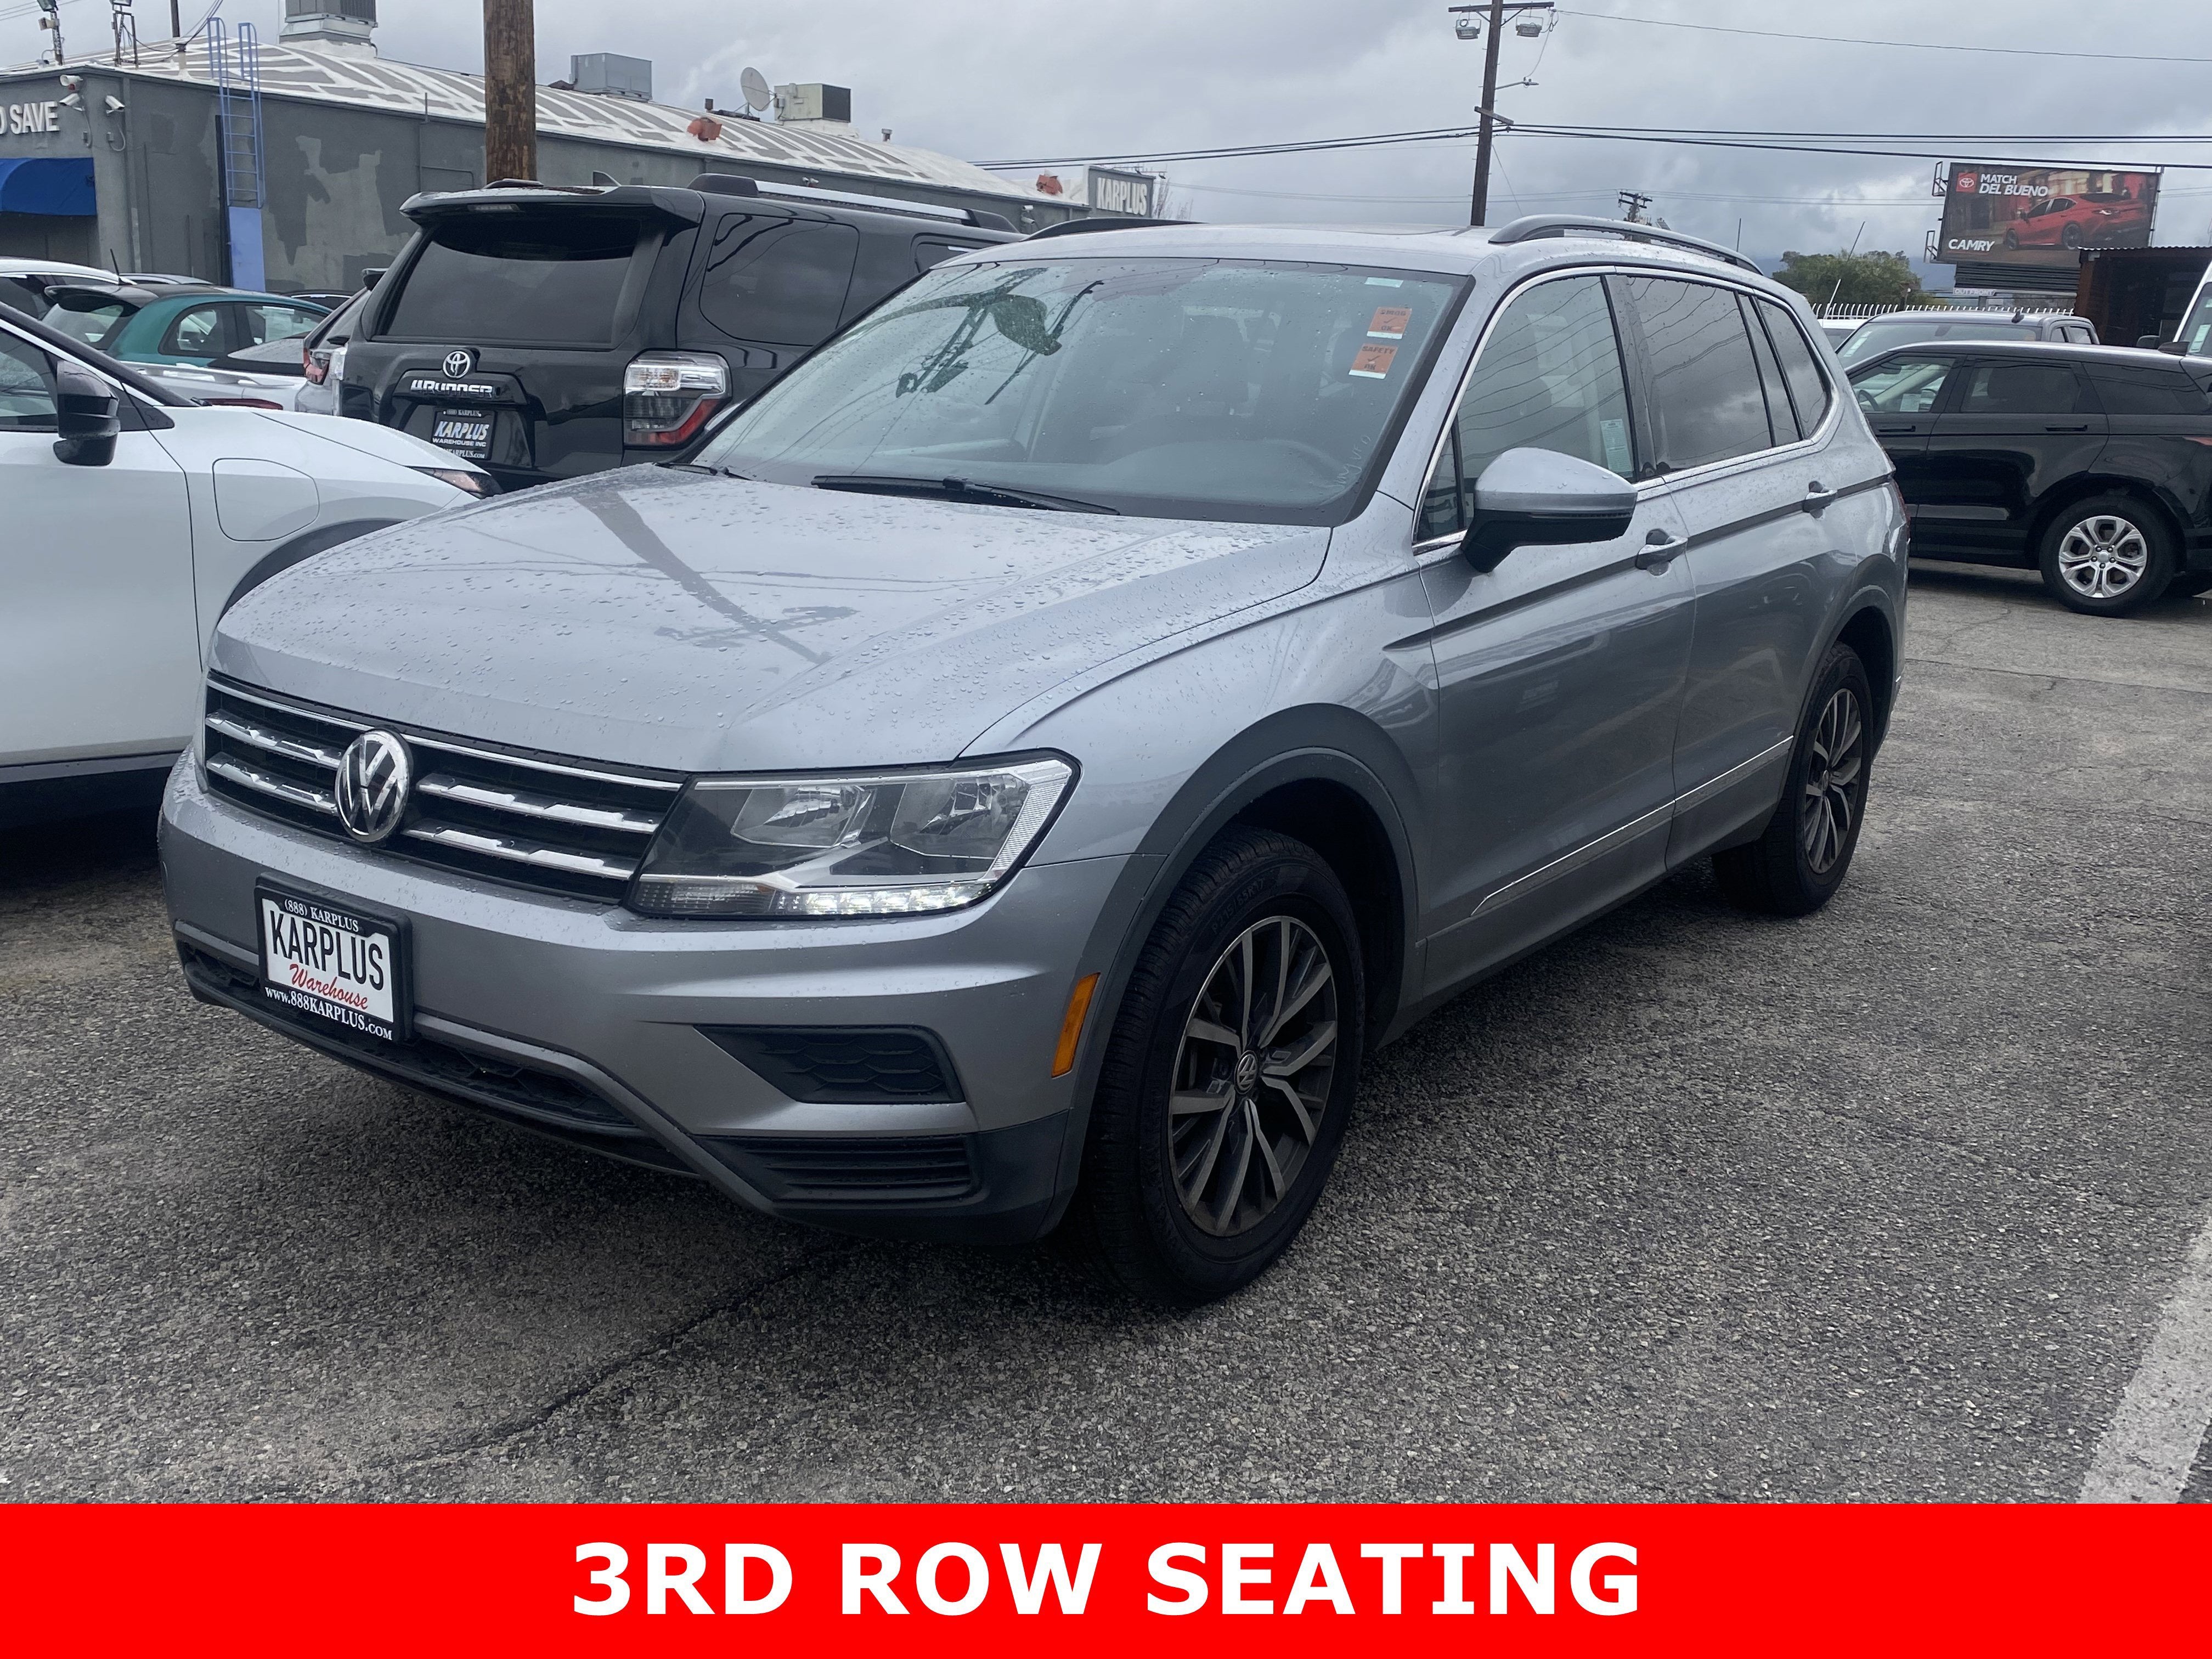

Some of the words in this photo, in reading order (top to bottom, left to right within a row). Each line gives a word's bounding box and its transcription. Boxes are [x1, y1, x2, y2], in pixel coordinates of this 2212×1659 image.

[9, 101, 60, 134] SAVE
[1980, 173, 2017, 184] MATCH
[1097, 177, 1148, 216] KARPLUS
[1979, 183, 2002, 195] DEL
[2004, 184, 2049, 197] BUENO
[1948, 239, 1995, 252] CAMRY
[1362, 346, 1395, 354] SAFETY
[435, 421, 489, 441] KARPLUS
[432, 438, 474, 447] WAREHOUSE
[284, 899, 307, 917] (888)
[310, 906, 359, 932] KARPLUS
[270, 910, 383, 990] KARPLUS
[290, 963, 369, 1010] Warehouse
